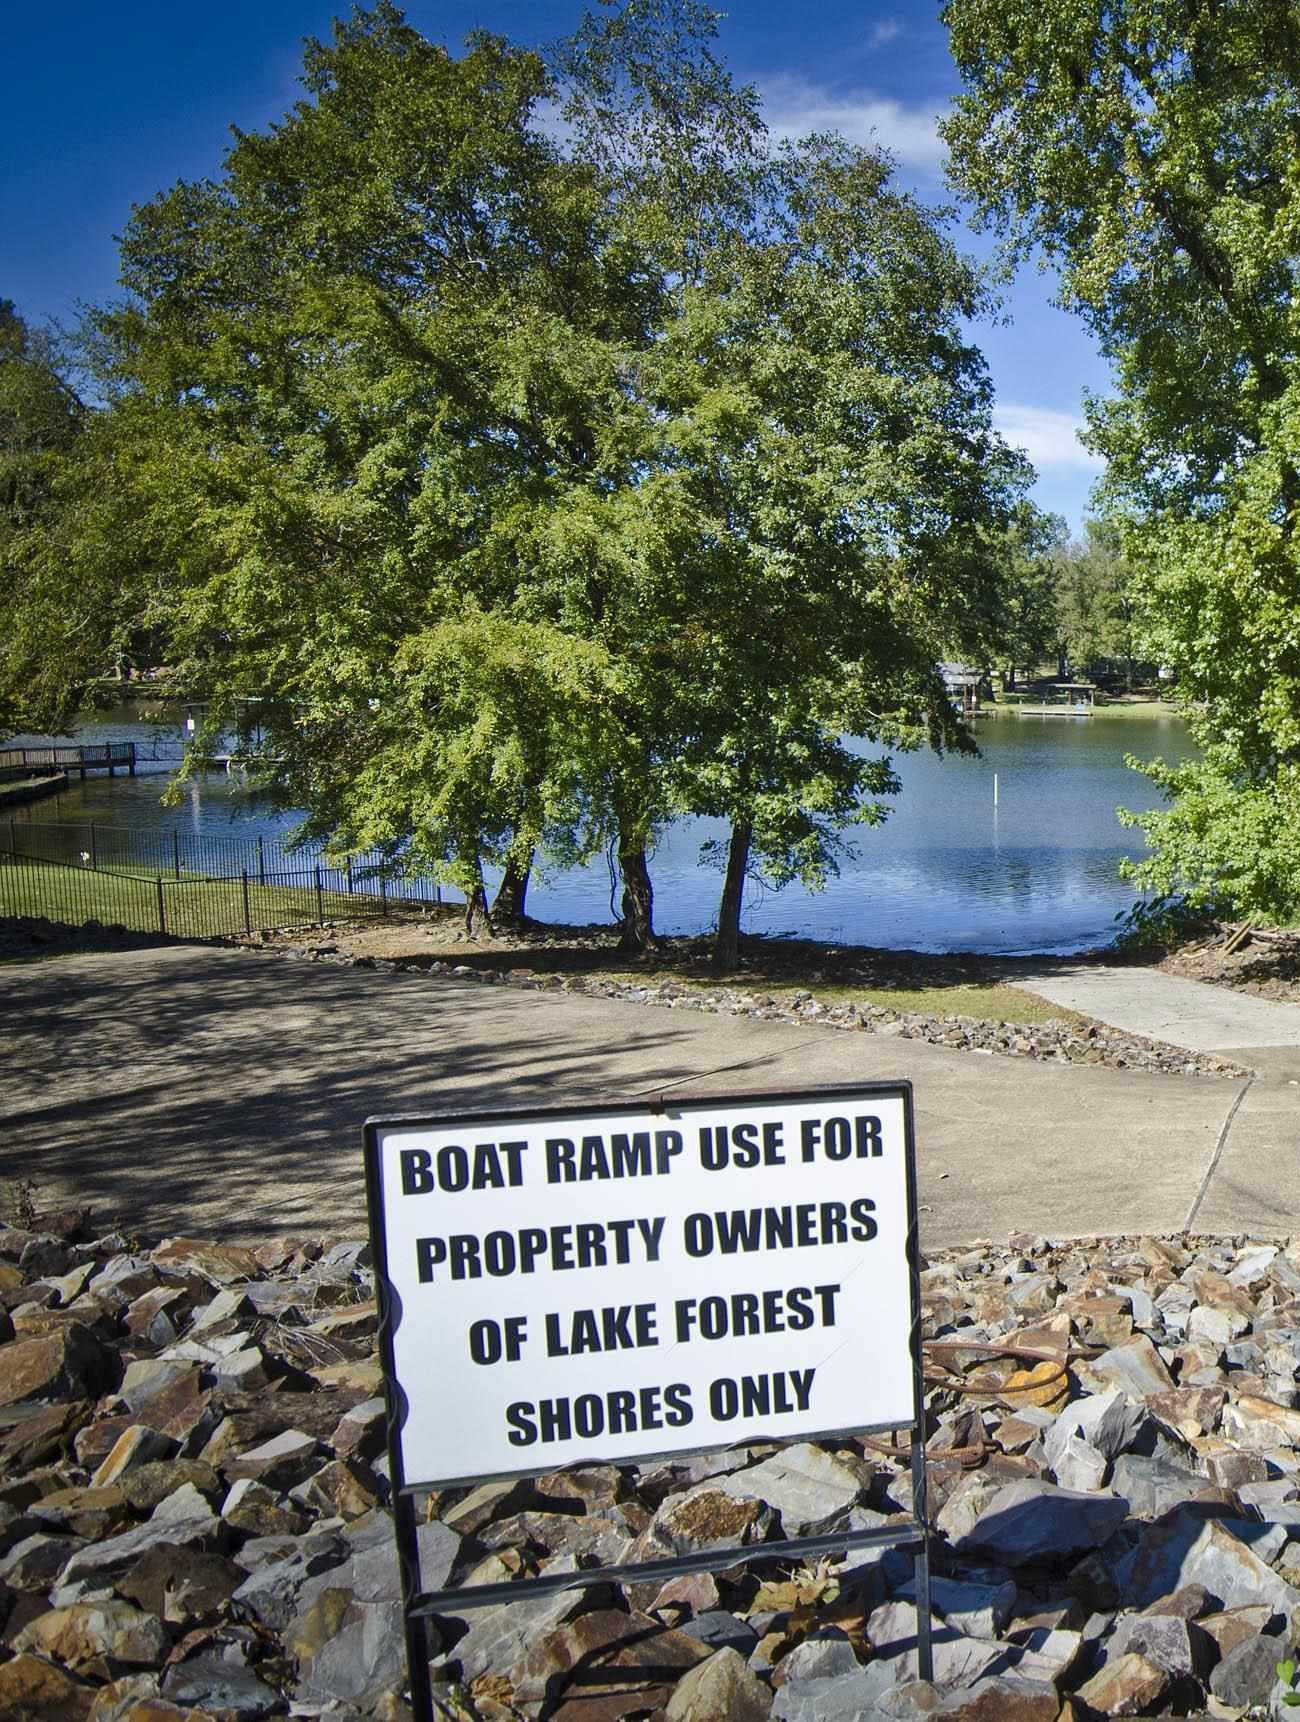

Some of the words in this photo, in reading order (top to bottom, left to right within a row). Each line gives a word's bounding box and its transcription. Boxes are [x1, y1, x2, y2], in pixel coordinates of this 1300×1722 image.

[399, 1140, 529, 1196] BOAT
[545, 1130, 683, 1184] RAMP
[699, 1122, 786, 1171] USE
[800, 1115, 883, 1163] FOR
[416, 1217, 666, 1284] PROPERTY
[684, 1198, 878, 1258] OWNERS
[469, 1316, 528, 1366] OF
[545, 1303, 659, 1358] LAKE
[675, 1284, 841, 1343] FOREST
[506, 1383, 694, 1447] SHORES
[709, 1367, 816, 1422] ONLY
